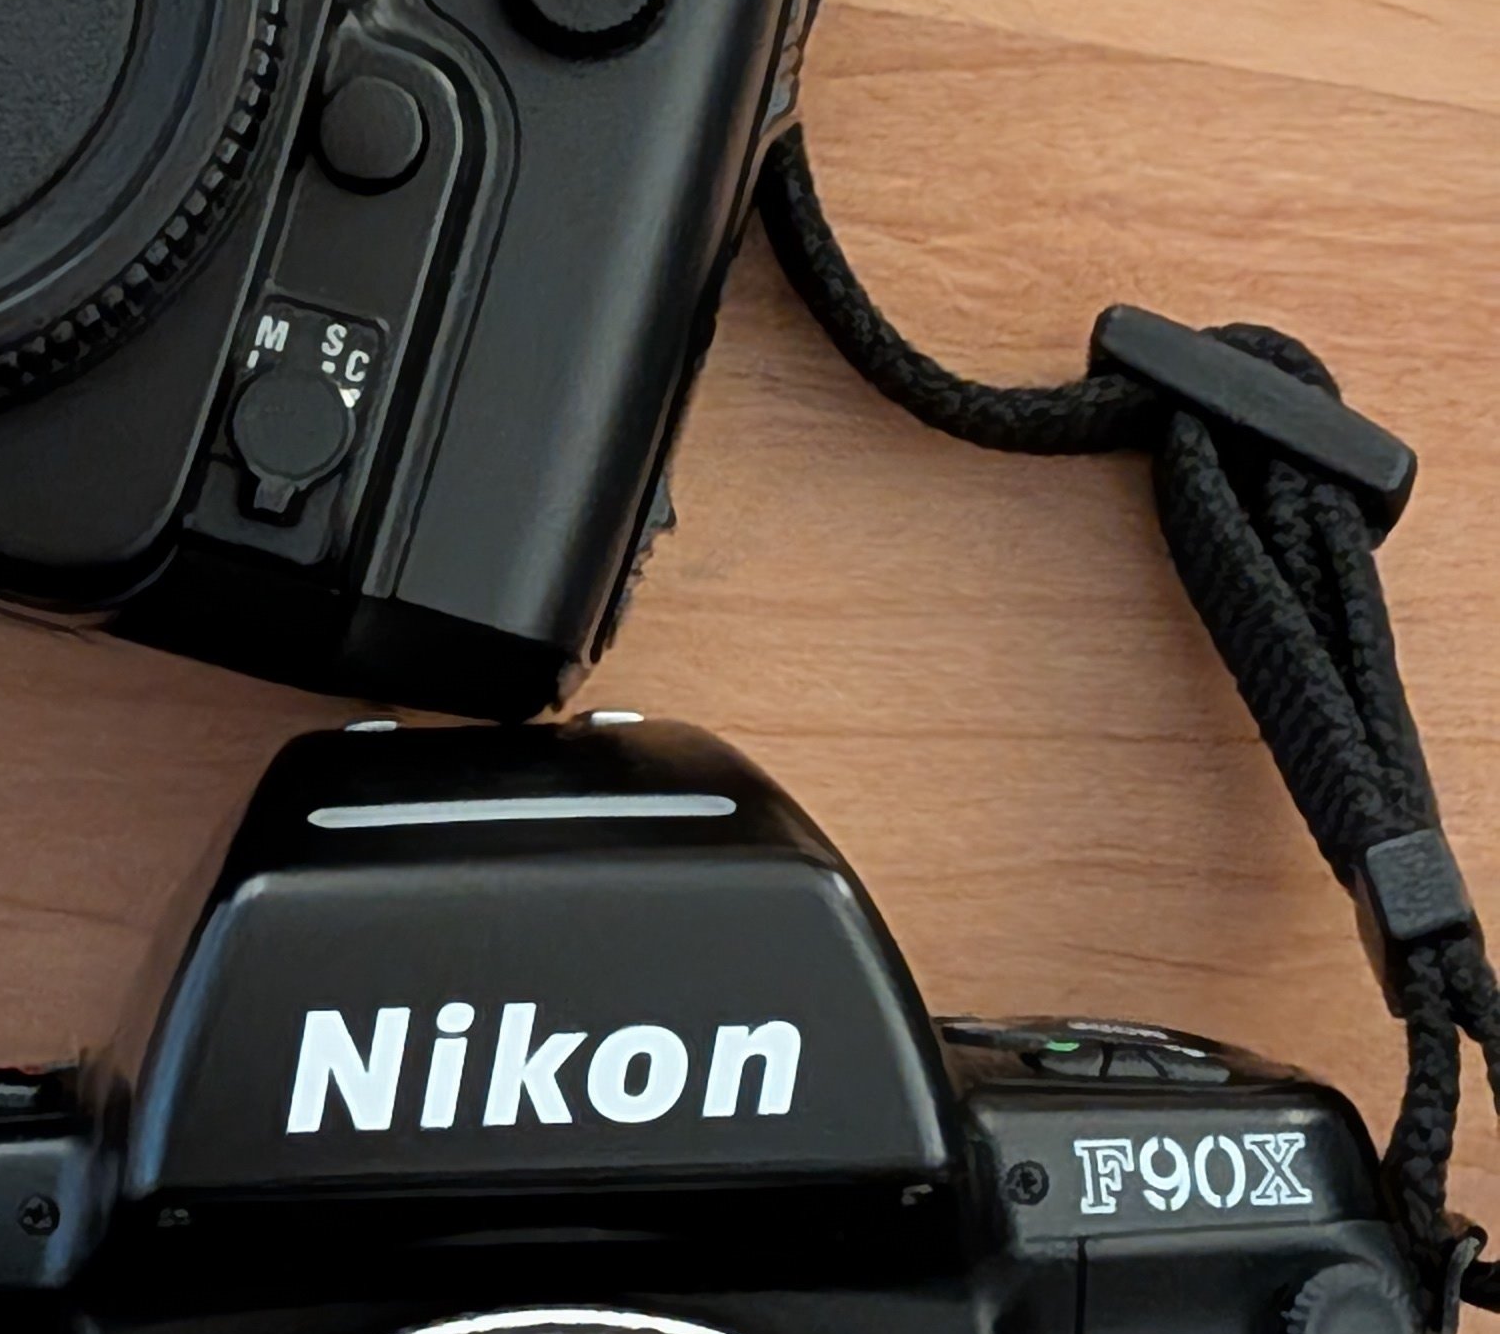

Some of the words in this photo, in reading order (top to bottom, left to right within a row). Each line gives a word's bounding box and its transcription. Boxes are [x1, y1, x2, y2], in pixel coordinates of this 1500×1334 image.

[254, 316, 289, 352] M
[321, 324, 347, 357] S
[345, 349, 370, 382] C
[286, 1001, 803, 1135] Nikon
[1073, 1131, 1314, 1216] F90X
